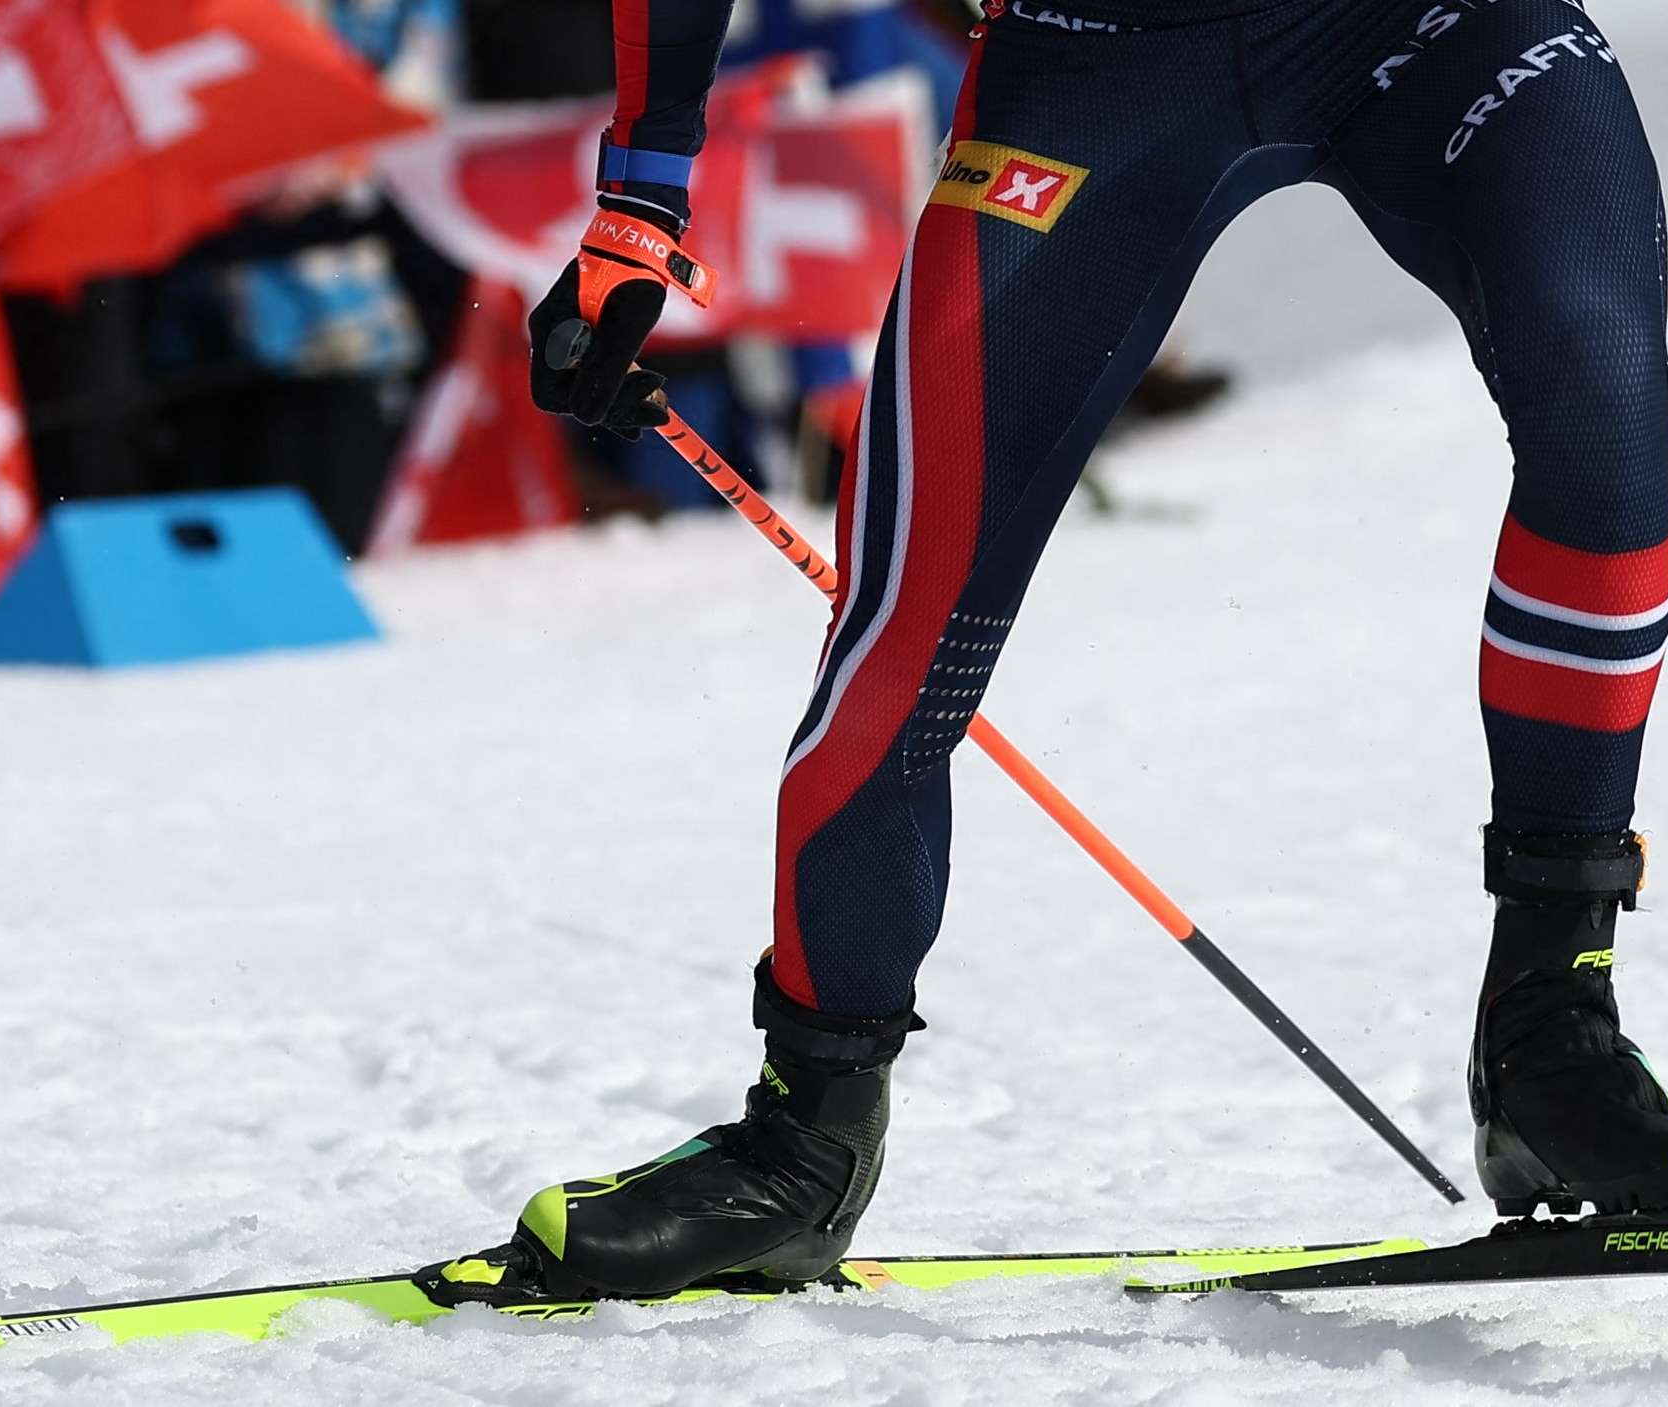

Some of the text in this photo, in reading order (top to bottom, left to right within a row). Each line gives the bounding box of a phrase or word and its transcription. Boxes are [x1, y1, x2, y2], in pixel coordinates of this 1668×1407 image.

[1445, 33, 1586, 164] CRAFT
[942, 160, 1060, 211] Uno X
